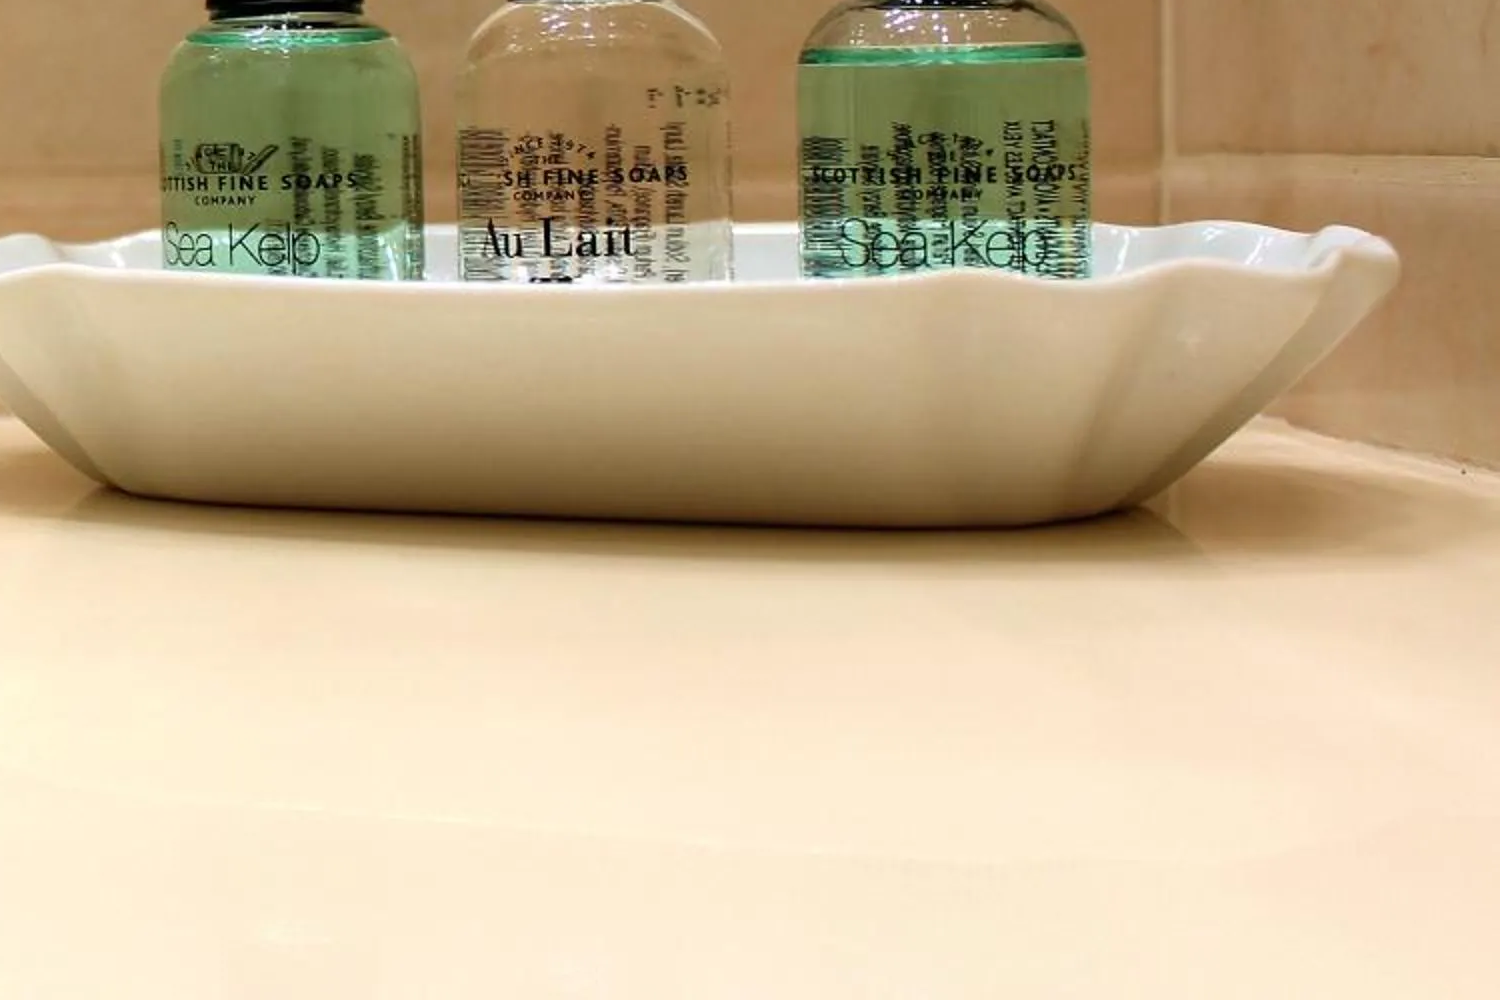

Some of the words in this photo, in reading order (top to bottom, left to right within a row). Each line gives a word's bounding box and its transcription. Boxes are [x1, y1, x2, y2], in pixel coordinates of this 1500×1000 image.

[218, 174, 269, 191] FINE
[281, 172, 361, 190] SOAPS
[543, 167, 599, 186] FINE
[611, 165, 688, 184] SOAPS
[194, 194, 257, 206] COMPANY
[163, 221, 216, 267] Sea
[228, 221, 321, 276] Kelp
[482, 216, 524, 259] Au
[539, 215, 638, 259] Lait
[840, 216, 931, 269] Sea
[950, 219, 1048, 275] Kelp
